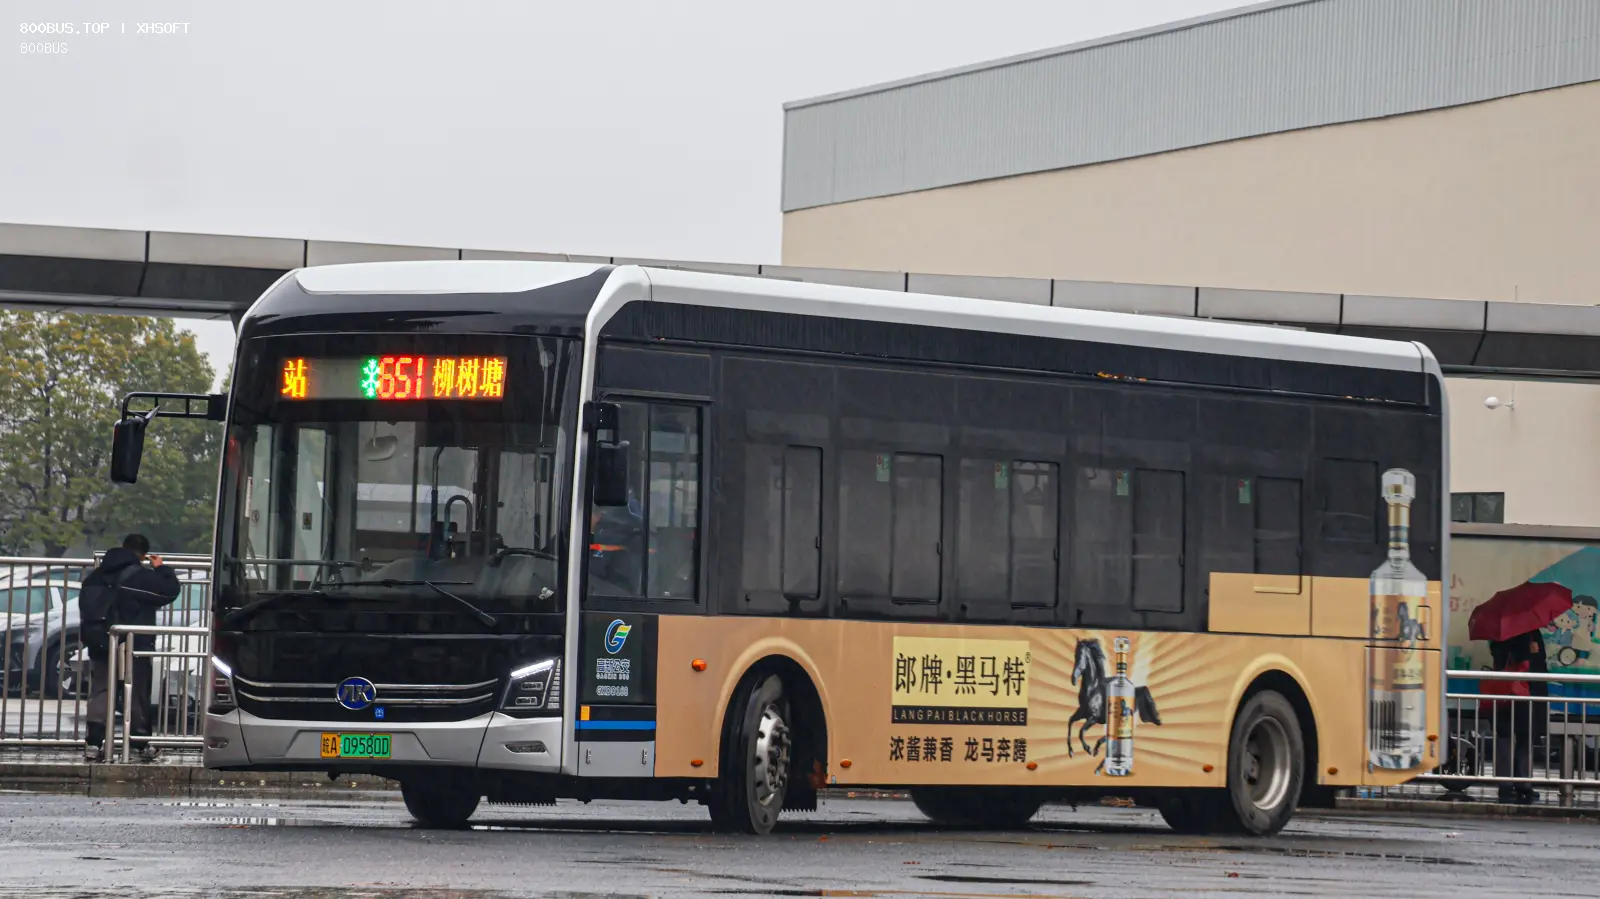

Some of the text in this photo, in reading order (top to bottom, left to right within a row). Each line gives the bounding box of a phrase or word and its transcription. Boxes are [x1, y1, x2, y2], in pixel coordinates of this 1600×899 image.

[281, 356, 505, 400] 站 651 柳树塘
[948, 710, 985, 722] BLACK
[987, 711, 1026, 723] HORSE
[889, 735, 1028, 763] 浓酱兼香 龙马奔腾
